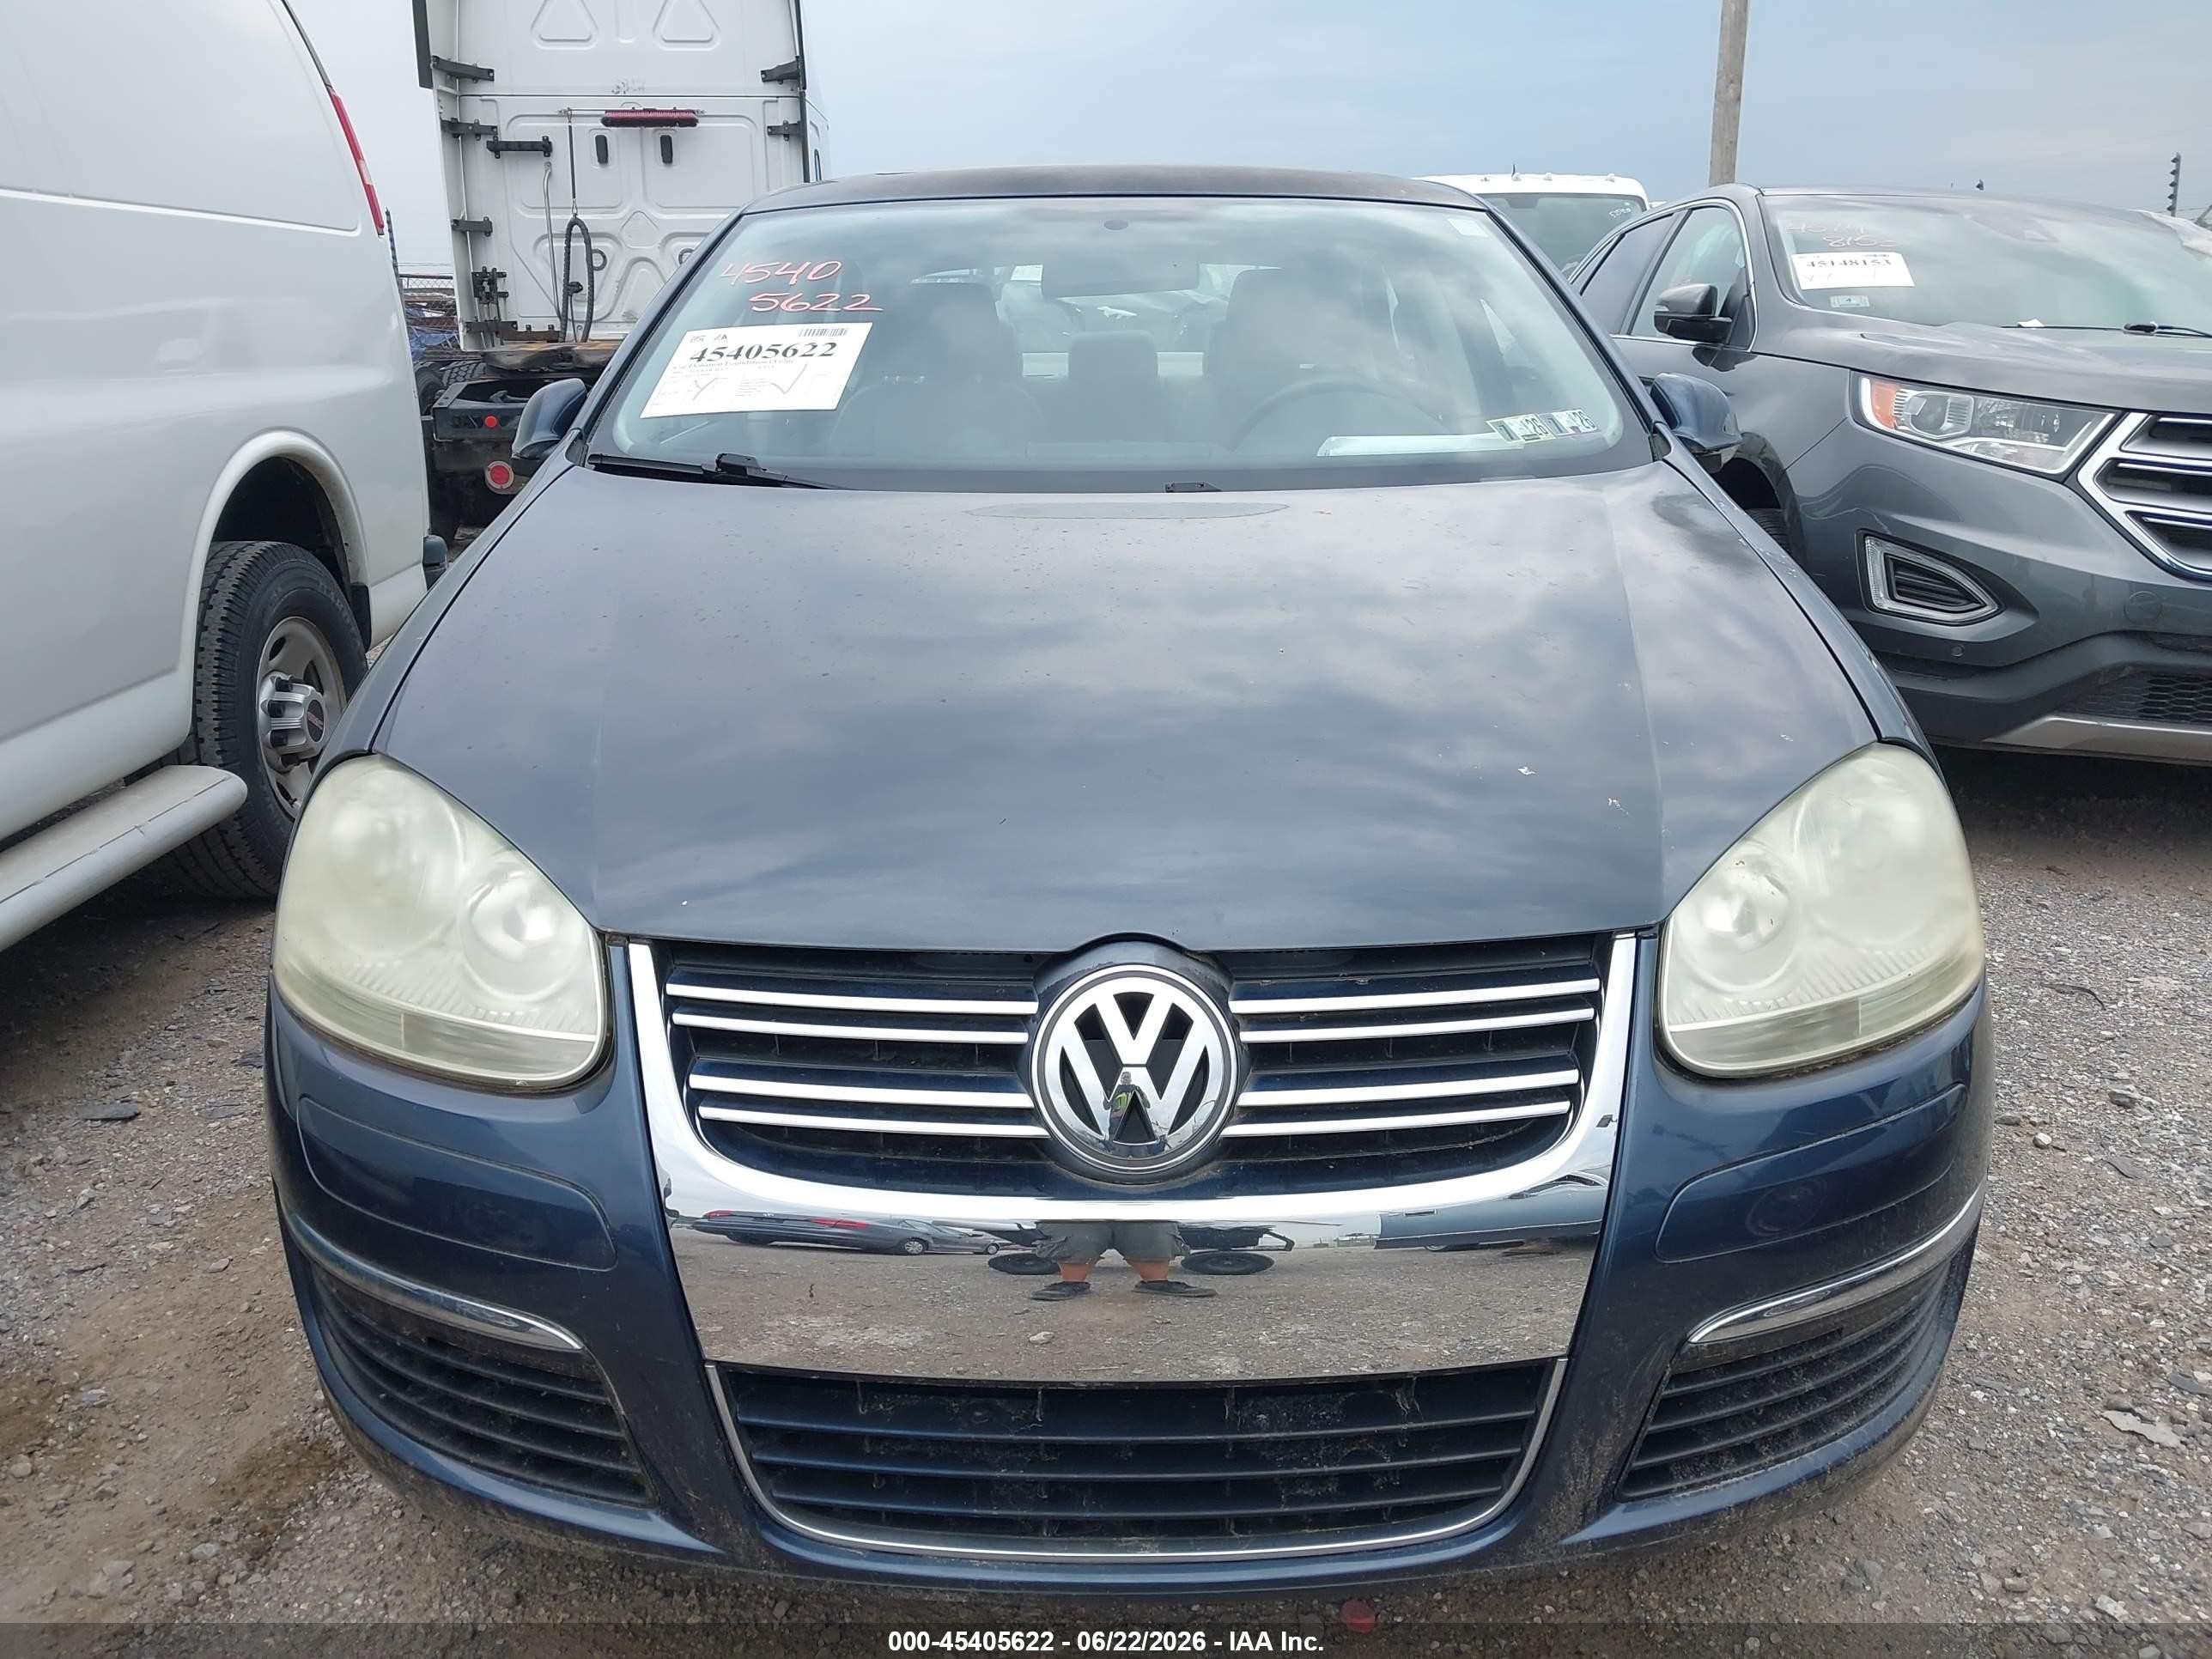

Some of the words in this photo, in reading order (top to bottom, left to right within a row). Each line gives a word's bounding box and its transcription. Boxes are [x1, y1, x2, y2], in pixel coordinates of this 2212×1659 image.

[720, 261, 842, 285] 4540
[749, 293, 884, 312] 5622
[690, 342, 837, 362] 45405622
[1525, 417, 1549, 436] 26
[1572, 411, 1596, 429] 26
